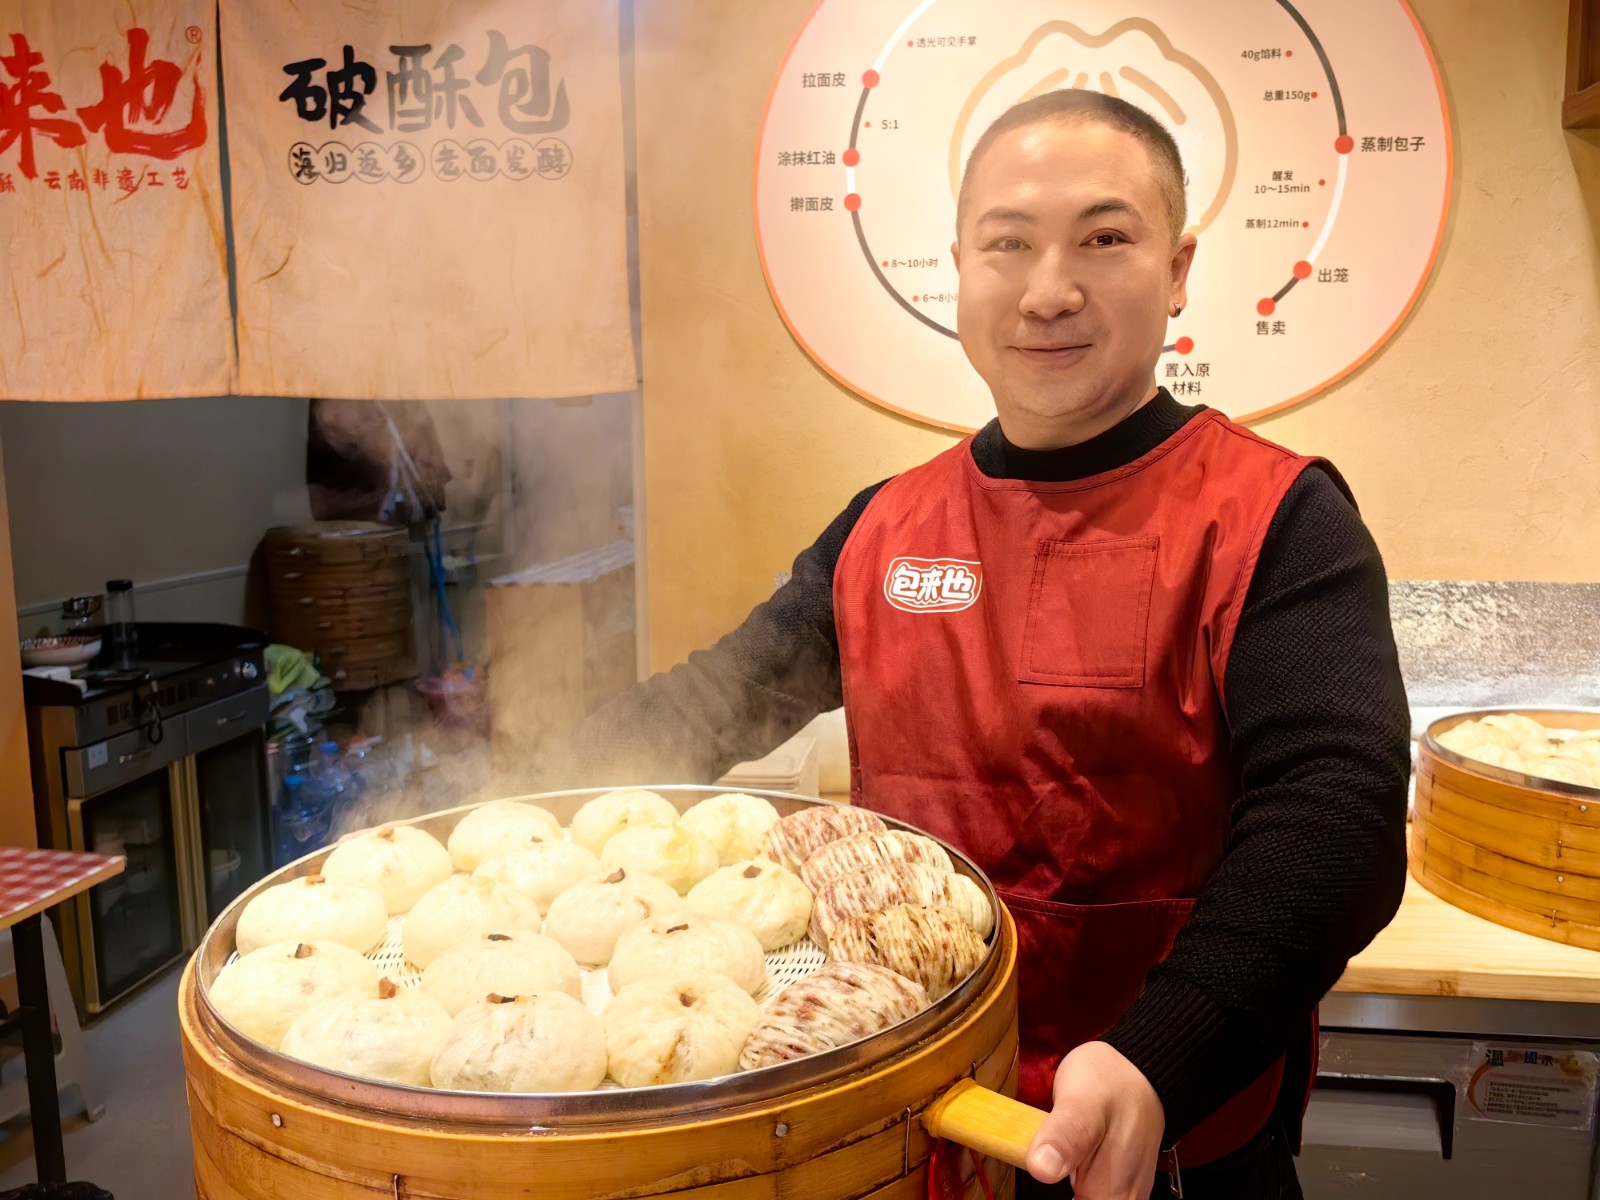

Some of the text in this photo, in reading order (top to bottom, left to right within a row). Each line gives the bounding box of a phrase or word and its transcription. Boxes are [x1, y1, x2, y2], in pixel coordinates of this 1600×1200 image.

[916, 36, 977, 48] 透光可见手掌
[1241, 48, 1281, 61] 40g馅料
[279, 29, 571, 135] 破酥包
[802, 72, 846, 88] 拉面皮
[1263, 90, 1310, 102] 总重150g
[881, 119, 899, 130] 5:1
[1361, 136, 1425, 152] 蒸制包子
[433, 142, 569, 178] 老面发酵
[777, 150, 836, 166] 涂抹红油
[44, 167, 189, 192] 云南非遗工艺
[1272, 170, 1293, 182] 醒发
[790, 197, 834, 212] 擀面皮
[1245, 218, 1299, 230] 蒸制12min
[1317, 268, 1349, 283] 出笼
[1256, 321, 1286, 335] 售卖
[1165, 363, 1211, 378] 置入原
[1172, 381, 1202, 396] 材料
[891, 564, 974, 602] 包来也
